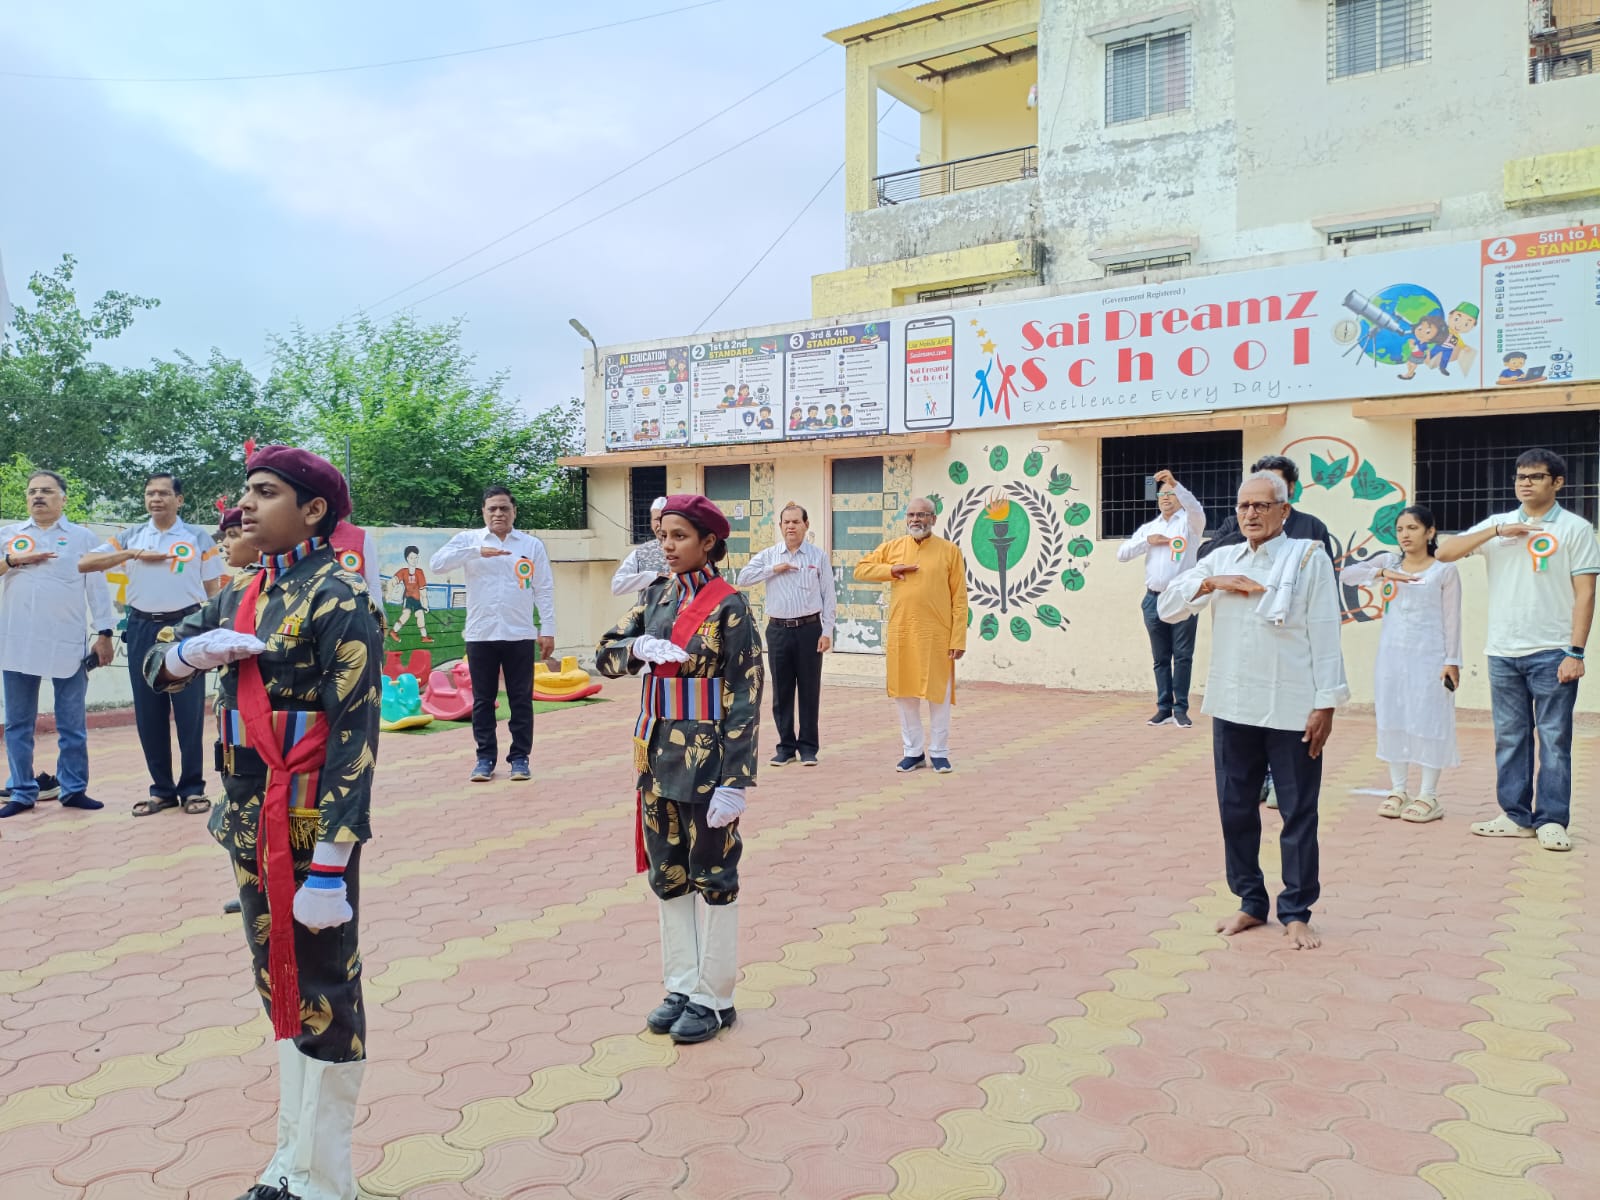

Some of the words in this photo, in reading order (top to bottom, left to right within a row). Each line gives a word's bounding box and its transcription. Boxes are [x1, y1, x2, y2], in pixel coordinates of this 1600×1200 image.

[1539, 232, 1564, 244] 5th
[1568, 229, 1585, 240] to
[1493, 241, 1509, 257] 4
[1021, 313, 1090, 351] Sai
[1105, 290, 1319, 342] Dreamz
[810, 331, 824, 340] 3rd
[825, 329, 832, 338] &
[834, 328, 848, 337] 4th
[709, 343, 723, 351] 1st
[723, 342, 731, 350] &
[731, 339, 747, 349] 2nd
[792, 335, 801, 348] 3
[806, 335, 856, 349] STANDARD
[619, 354, 629, 366] AI
[630, 350, 667, 363] EDUCATION
[694, 346, 703, 358] 2
[709, 347, 753, 359] STANDARD
[1021, 327, 1310, 392] School
[1023, 393, 1137, 413] Excellence
[1151, 384, 1218, 404] Every
